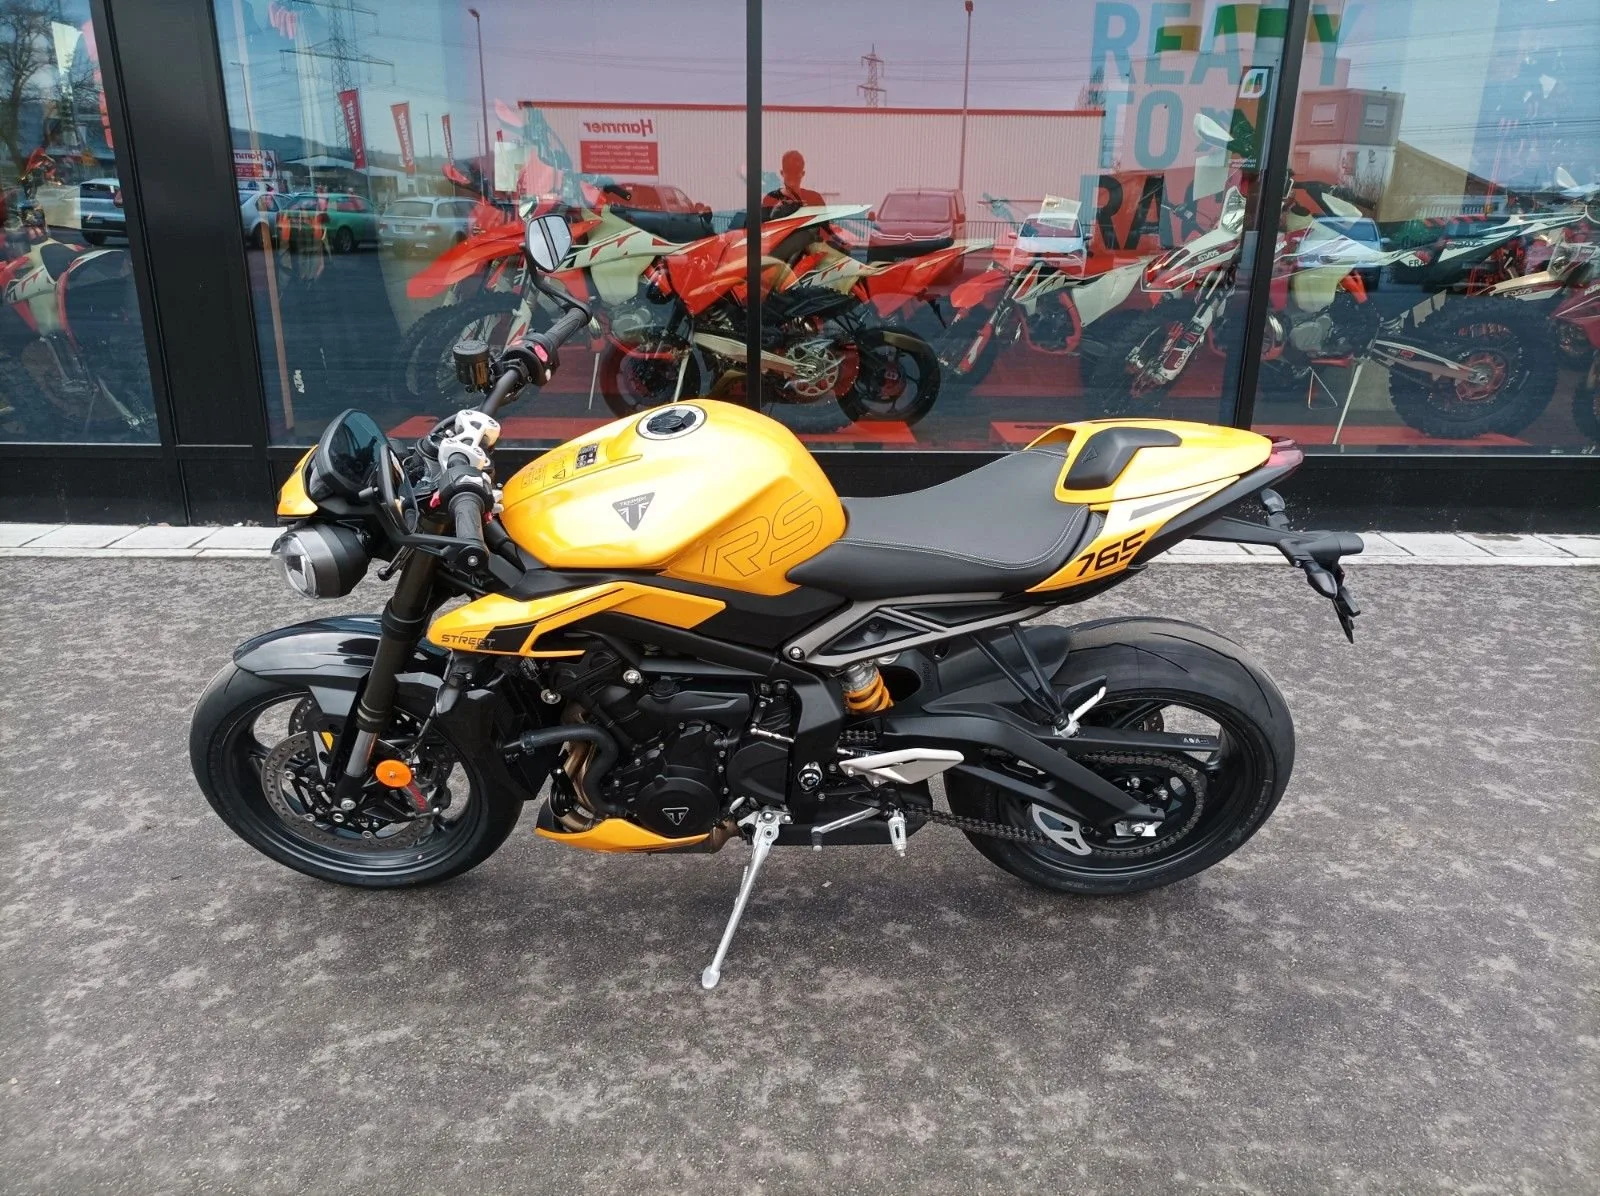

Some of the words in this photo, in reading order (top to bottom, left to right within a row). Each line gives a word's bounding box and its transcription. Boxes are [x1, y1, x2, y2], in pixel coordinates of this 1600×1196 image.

[1091, 90, 1184, 170] TO
[701, 489, 824, 578] RS
[1077, 529, 1147, 577] 765
[441, 634, 496, 647] STREET
